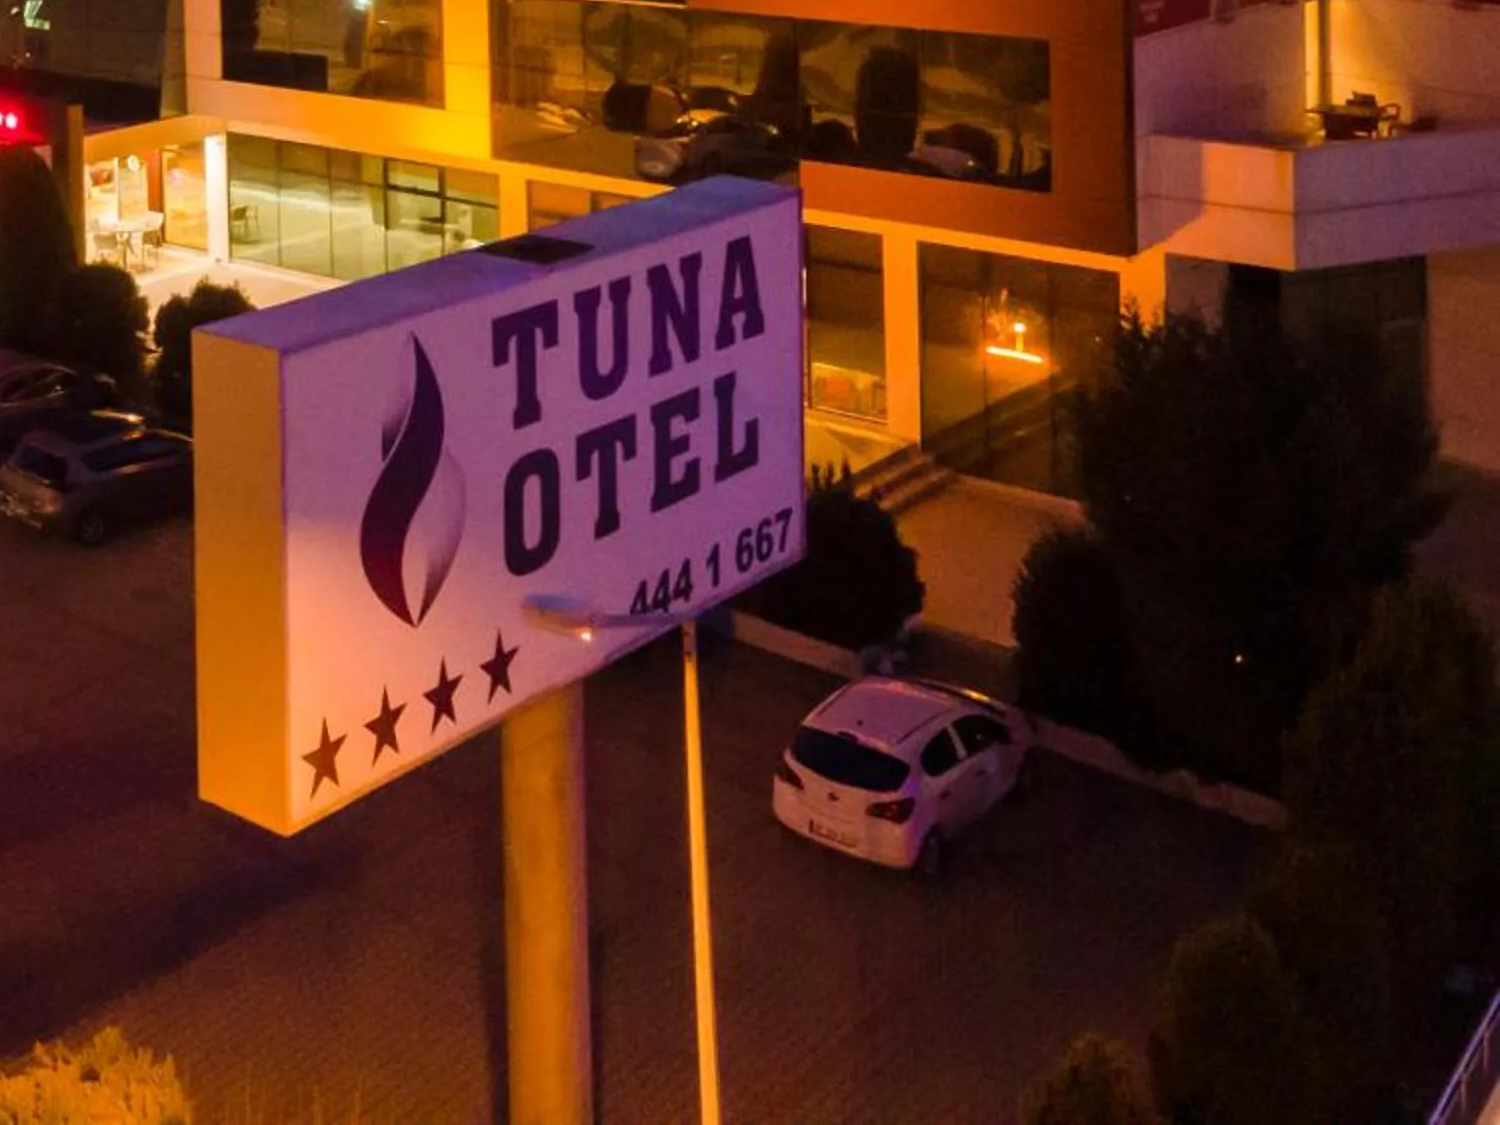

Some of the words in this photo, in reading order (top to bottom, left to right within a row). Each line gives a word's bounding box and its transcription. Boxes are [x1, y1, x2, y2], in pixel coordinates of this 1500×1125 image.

[492, 235, 765, 431] TUNA
[504, 371, 759, 577] OTEL
[630, 557, 694, 615] 444
[706, 542, 720, 588] 1
[735, 506, 793, 574] 667
